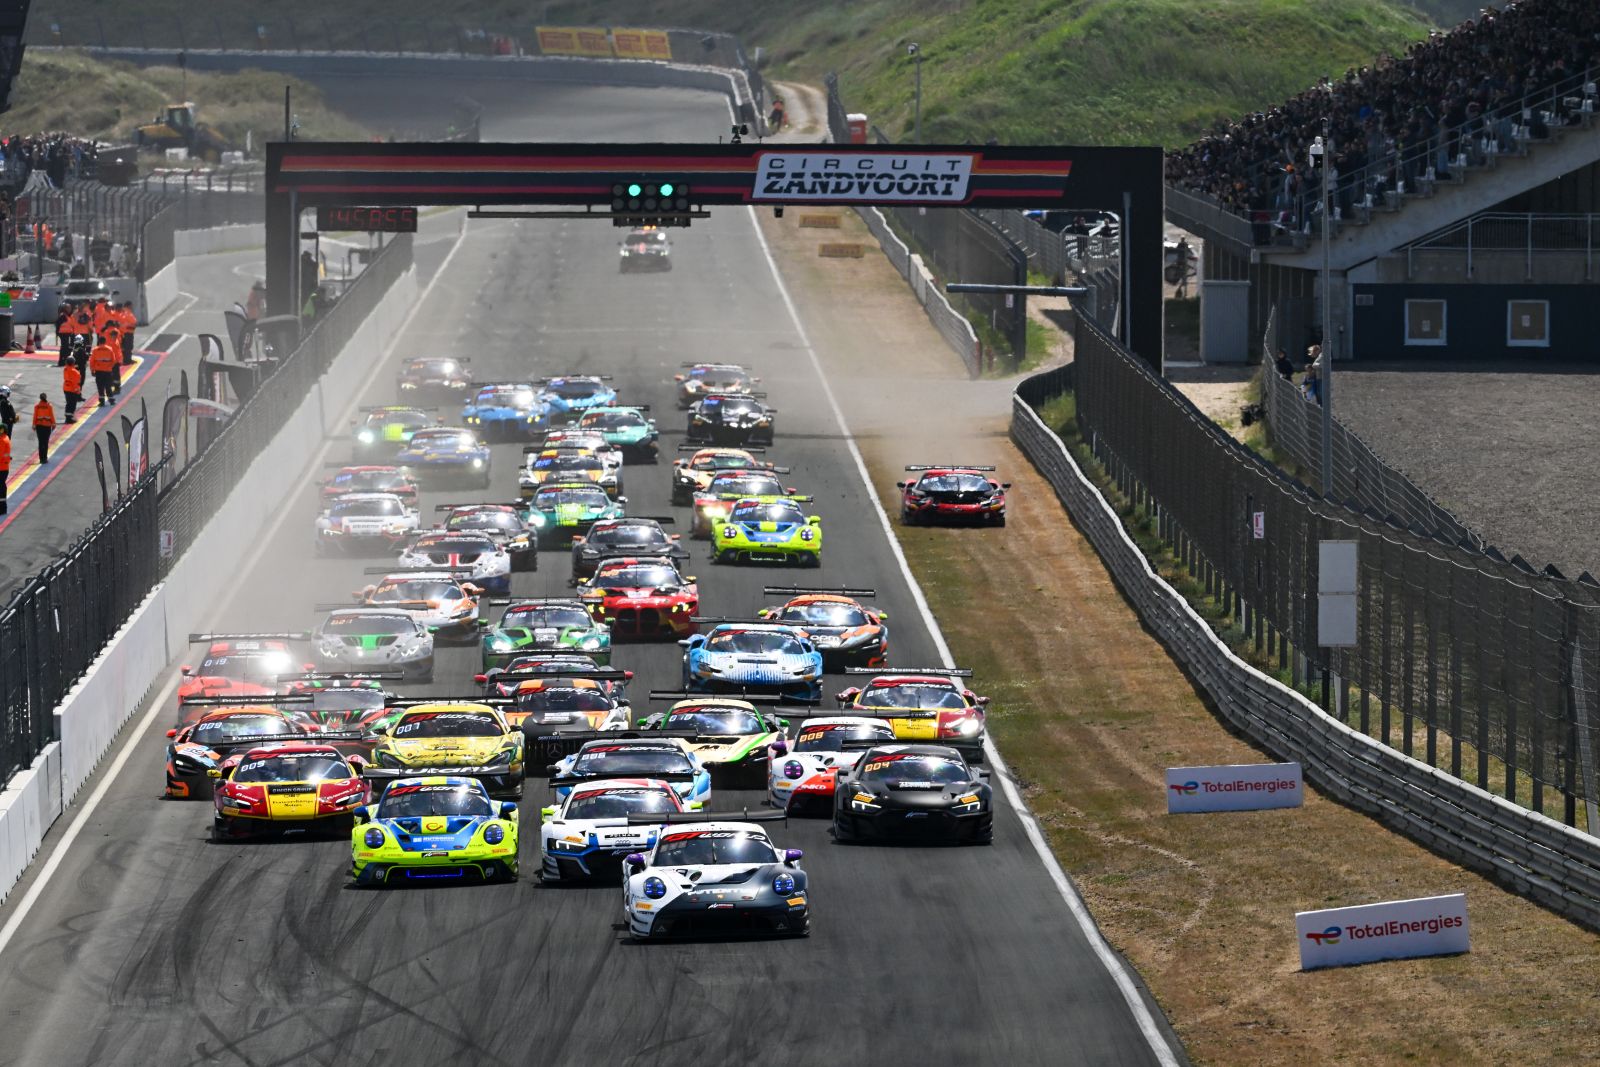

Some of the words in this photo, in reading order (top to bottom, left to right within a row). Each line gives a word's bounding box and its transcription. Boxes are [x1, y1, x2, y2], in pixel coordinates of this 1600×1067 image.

[769, 157, 962, 171] CIRCUIT
[763, 172, 960, 196] ZANDVOORT
[1201, 778, 1296, 793] TotalEnergies
[1345, 914, 1463, 940] TotalEnergies
